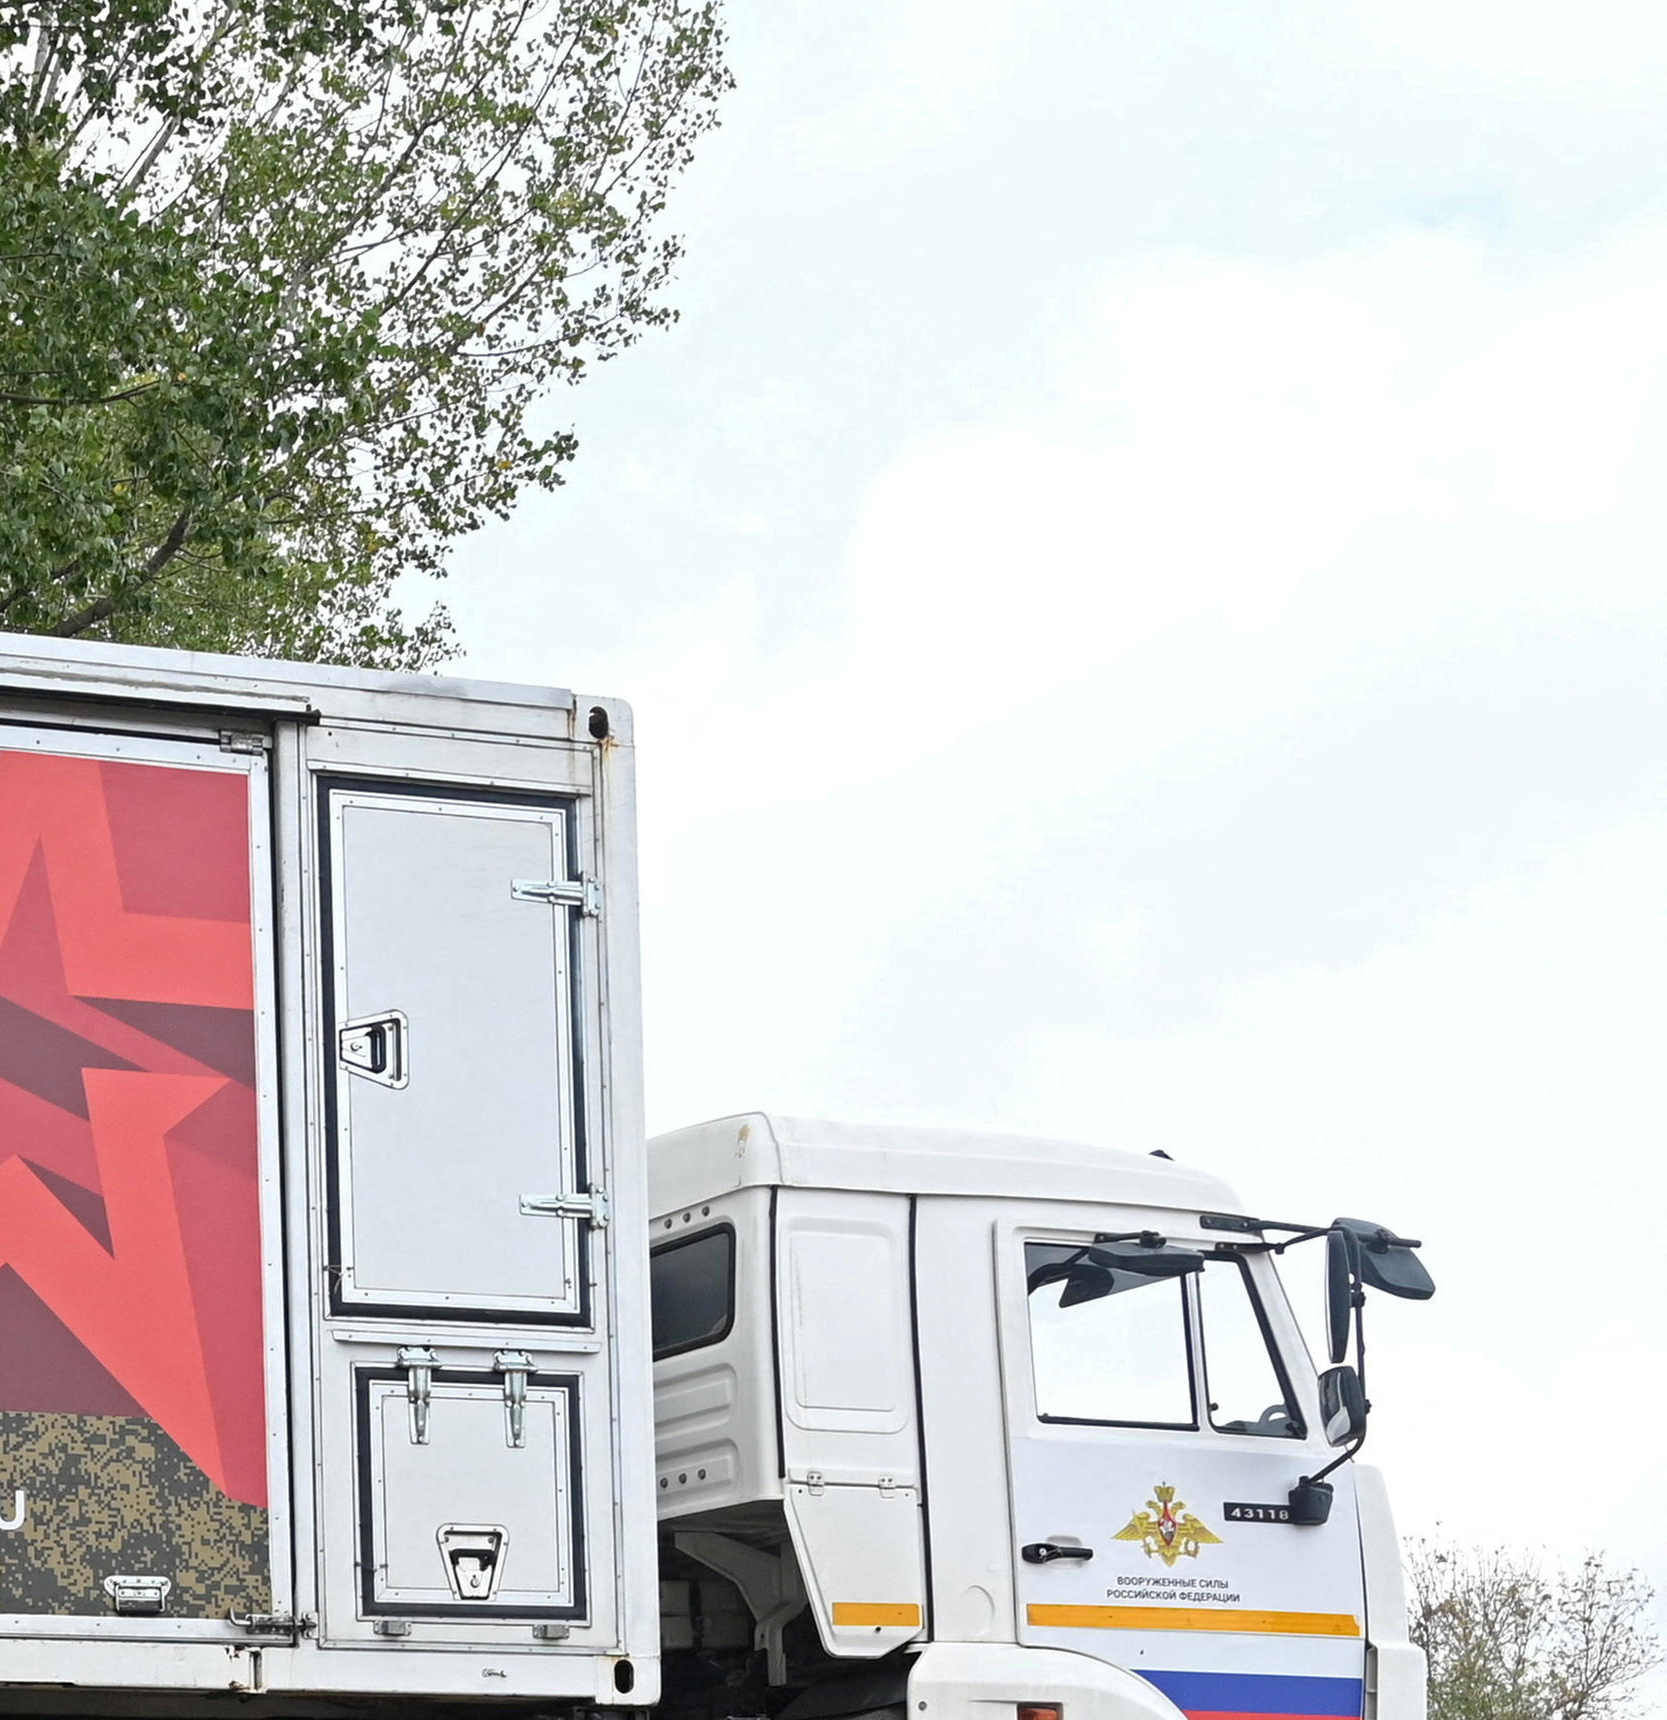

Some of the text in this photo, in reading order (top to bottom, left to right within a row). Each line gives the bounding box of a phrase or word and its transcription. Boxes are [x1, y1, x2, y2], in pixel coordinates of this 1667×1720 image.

[1230, 1506, 1290, 1521] 43118
[1116, 1576, 1229, 1590] ВООРУЖЕННЫЕ СИЛЫ
[1106, 1588, 1241, 1604] РОССИЙСКОЙ ФЕДЕРАЦИИ
